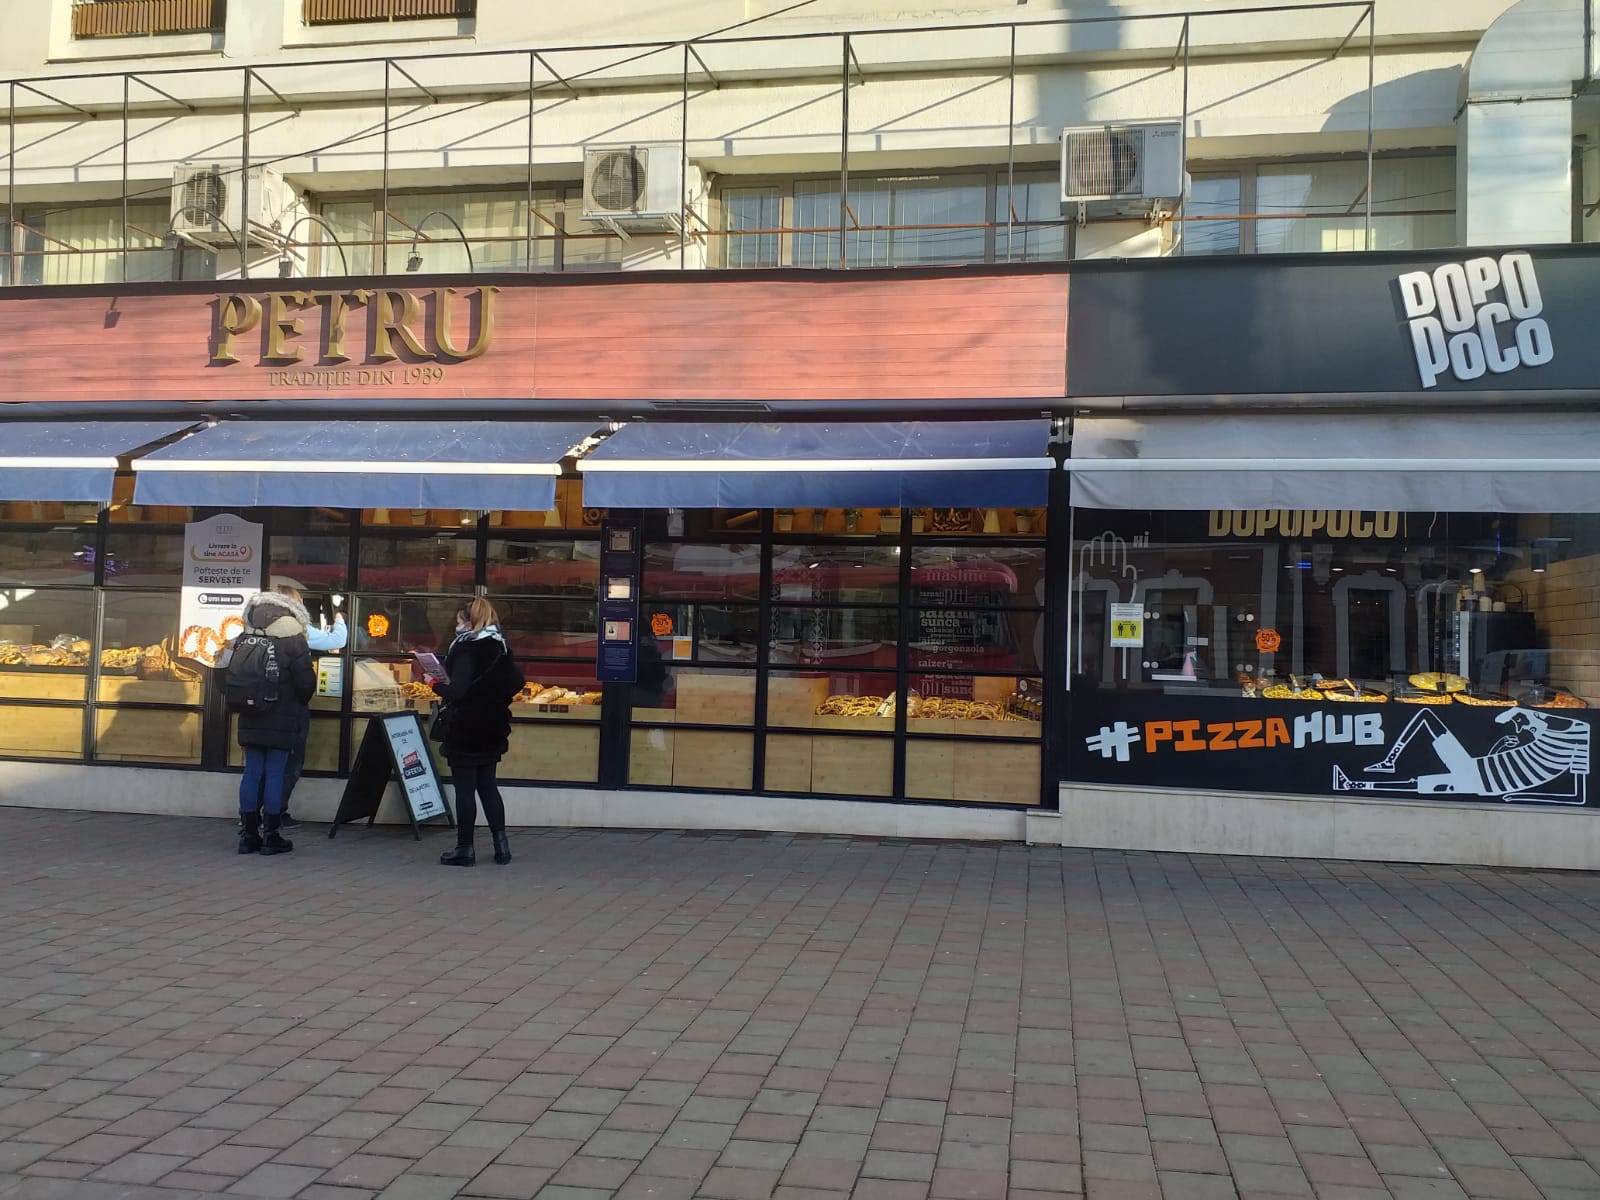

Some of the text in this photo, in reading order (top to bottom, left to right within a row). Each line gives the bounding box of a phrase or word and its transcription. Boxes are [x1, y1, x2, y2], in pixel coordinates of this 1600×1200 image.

[1398, 251, 1544, 333] DOPO
[211, 286, 501, 362] PETRU
[358, 369, 395, 386] DIN
[402, 366, 445, 386] 1939
[230, 567, 241, 575] de
